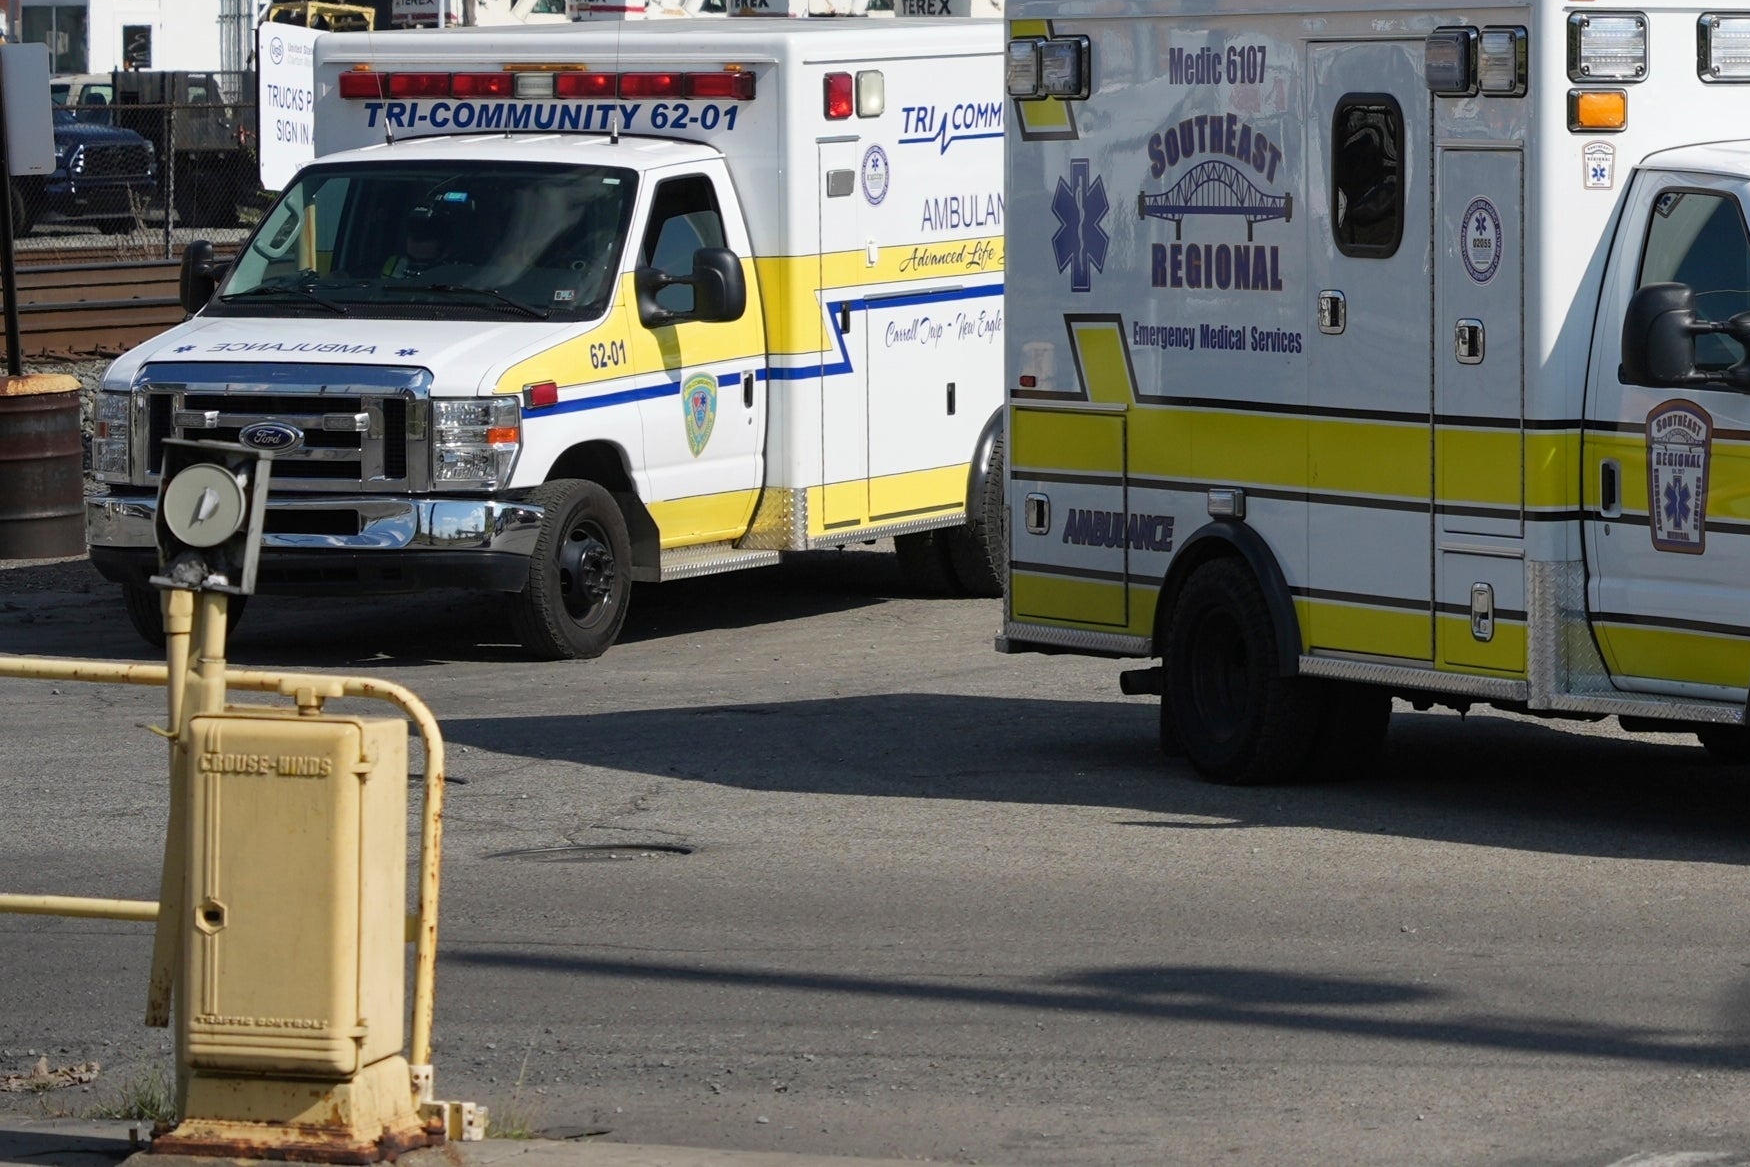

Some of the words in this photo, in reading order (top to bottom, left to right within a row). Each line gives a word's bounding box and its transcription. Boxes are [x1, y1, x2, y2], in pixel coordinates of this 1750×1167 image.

[1168, 47, 1222, 85] Medic
[1226, 45, 1267, 84] 6107
[267, 84, 304, 112] TRUCKS
[276, 119, 299, 143] SIGN
[300, 123, 309, 145] IN
[363, 102, 642, 131] TRI-COMMUNITY
[650, 103, 739, 131] 62-01
[902, 105, 936, 134] TRI
[951, 101, 1005, 130] COMM
[1147, 112, 1283, 185] SOUTHEAST
[899, 245, 967, 273] Advanced
[966, 240, 996, 270] Life
[1472, 238, 1492, 249] 02055
[1151, 242, 1283, 291] REGIONAL
[885, 317, 919, 349] Carroll
[955, 311, 976, 341] New
[977, 309, 1003, 345] Eagle
[1133, 321, 1195, 352] Emergency
[1200, 323, 1246, 351] Medical
[1251, 325, 1303, 354] Services
[590, 339, 627, 370] 62-01
[253, 429, 282, 445] Ford
[1655, 413, 1703, 437] SOUTHEAST
[1655, 451, 1702, 469] REGIONAL
[1653, 468, 1664, 533] EMERGENCY
[1693, 476, 1702, 531] SERVICES
[1062, 508, 1175, 553] AMBULANCE
[199, 752, 333, 778] CROUSE-HINDS
[194, 1014, 254, 1027] TRAFFIC
